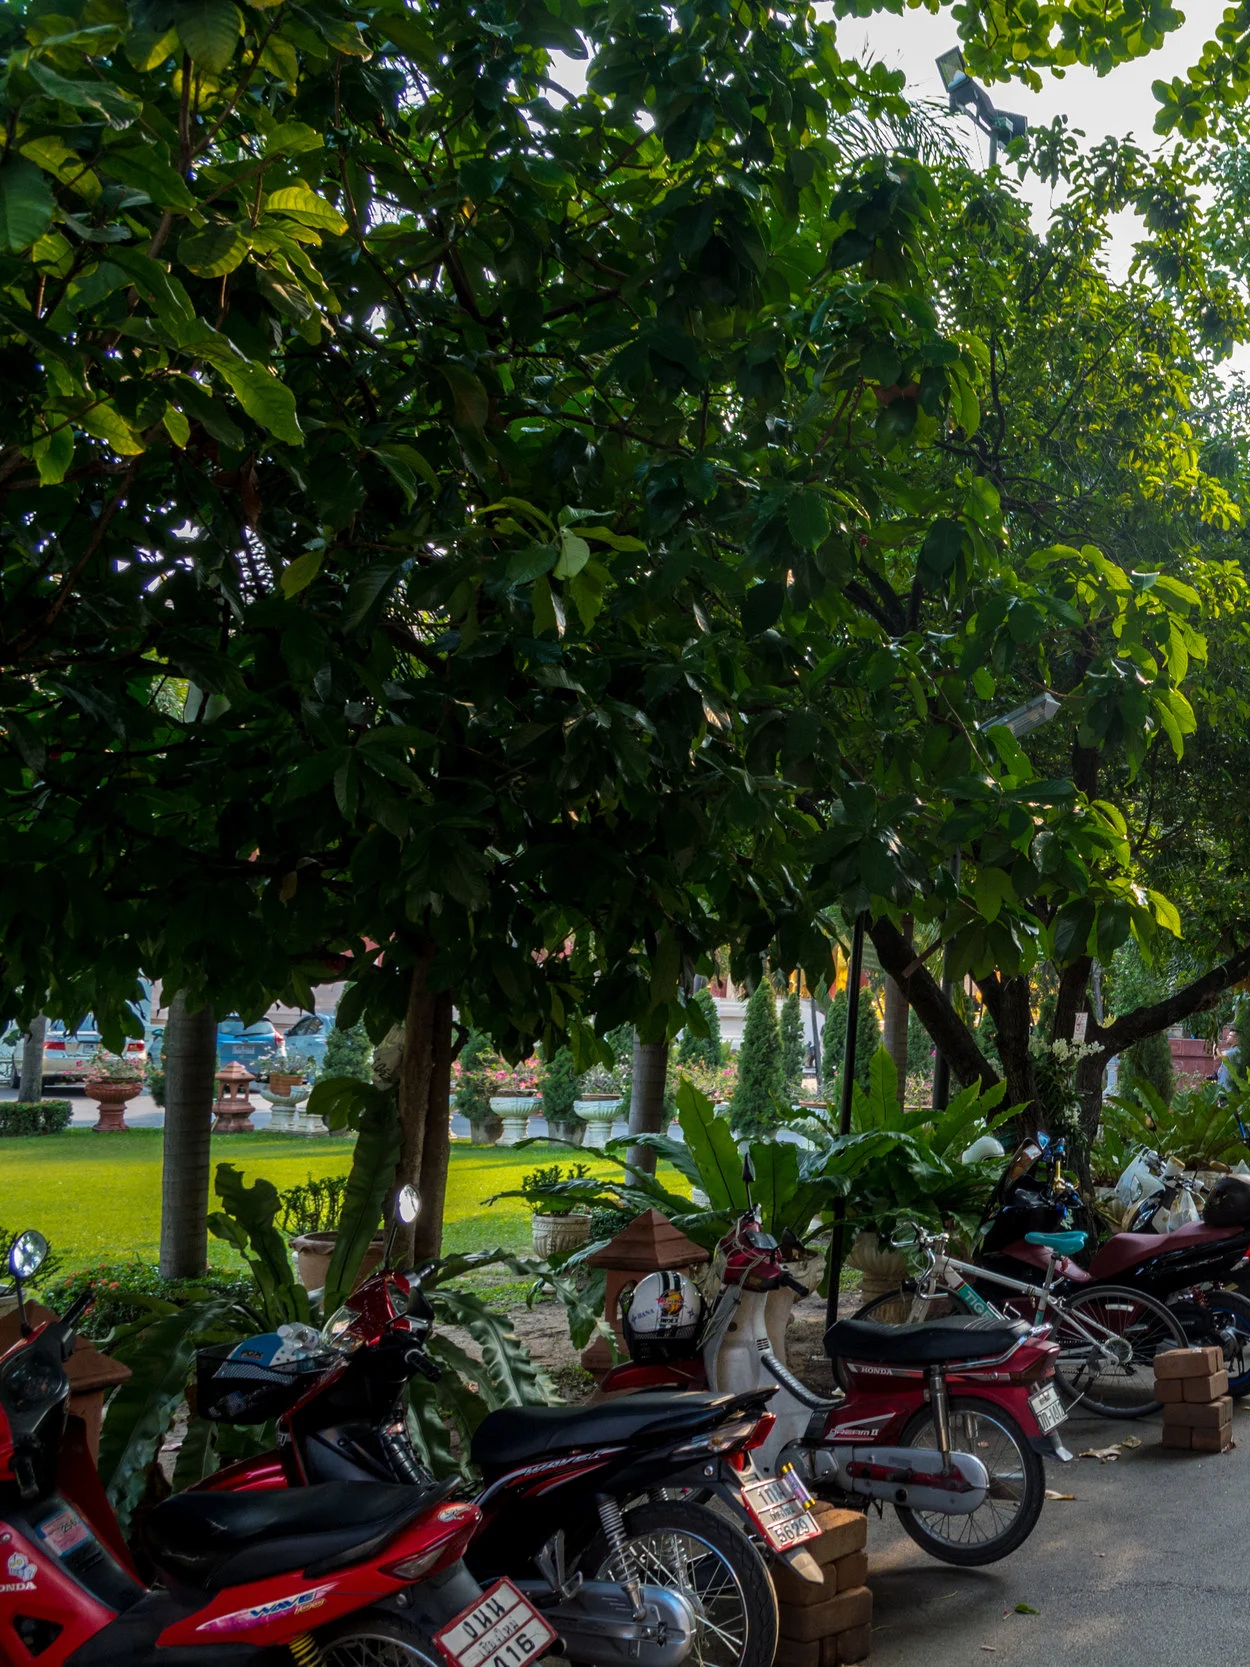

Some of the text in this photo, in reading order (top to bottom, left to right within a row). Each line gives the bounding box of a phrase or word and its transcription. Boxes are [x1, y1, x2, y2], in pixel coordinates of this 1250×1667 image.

[861, 1366, 893, 1375] HONDA
[774, 1518, 809, 1542] 5629
[249, 1591, 316, 1617] WAVE
